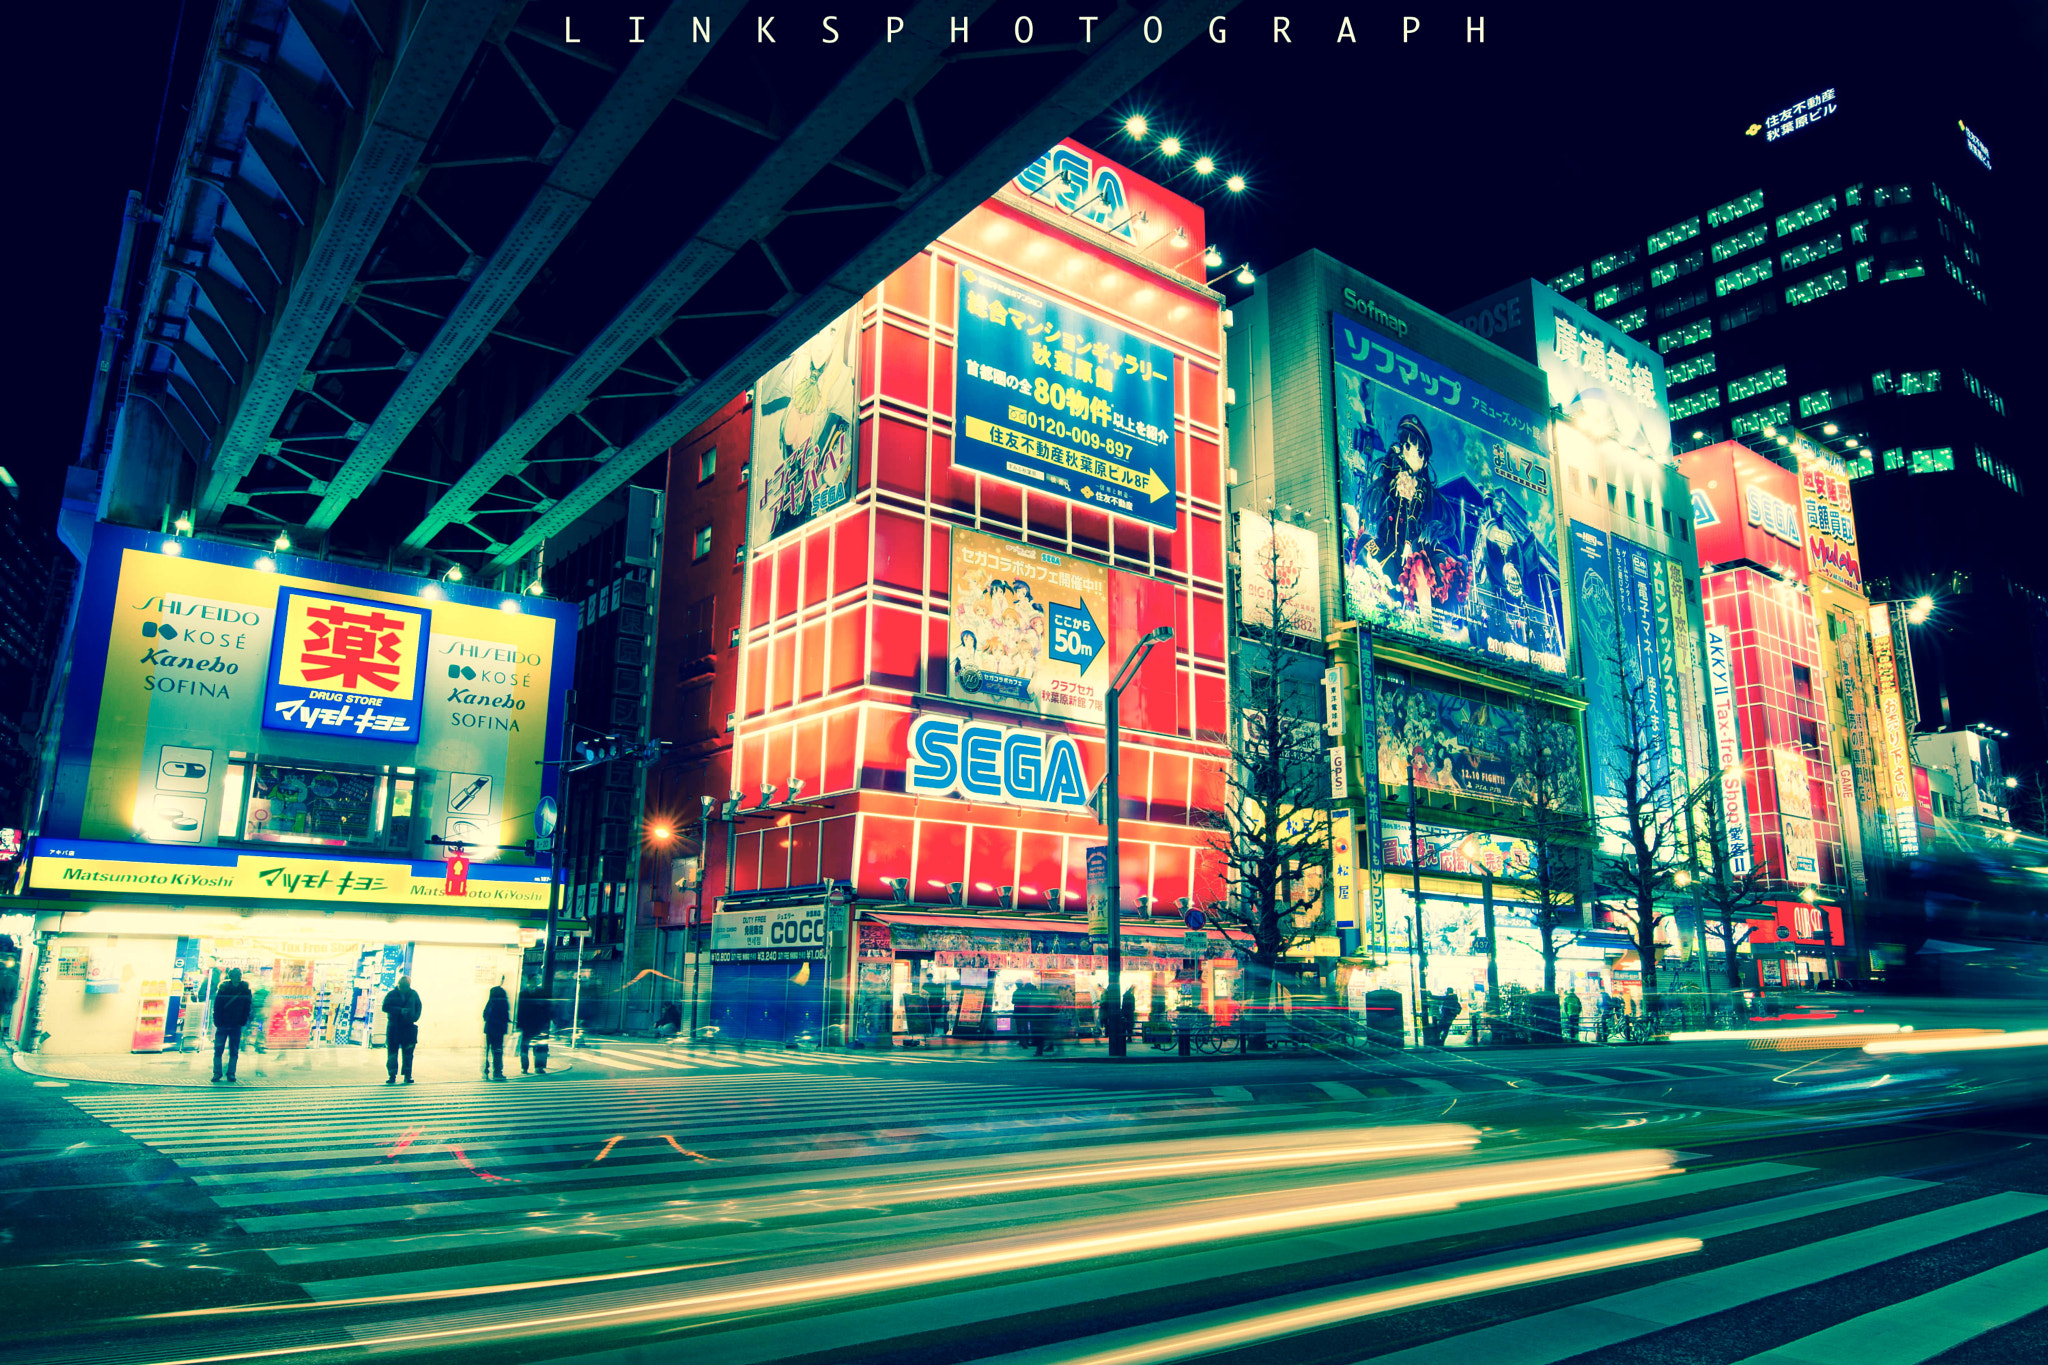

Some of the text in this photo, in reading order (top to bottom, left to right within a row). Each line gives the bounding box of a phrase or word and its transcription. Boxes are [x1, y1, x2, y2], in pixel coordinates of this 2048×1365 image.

[1764, 88, 1836, 129] 住友不動産
[1766, 102, 1837, 142] 秋葉原ビル
[1010, 145, 1137, 247] EGA
[1343, 287, 1408, 338] Sofmap
[966, 290, 1168, 381] 総合マンションギャラリー
[1344, 328, 1462, 406] ソフマップ
[1027, 411, 1133, 460] 0120-009-897
[990, 425, 1150, 489] 住友不動産秋葉原ビル8F
[811, 481, 846, 515] SEGA
[1095, 491, 1133, 511] 住友不動産
[1746, 486, 1801, 546] SEGA
[1805, 499, 1855, 545] 高額買取
[1041, 553, 1061, 566] SEGA
[132, 596, 259, 626] SHISEIDO
[1054, 613, 1091, 632] ここから
[184, 628, 246, 649] KOSÉ
[301, 605, 405, 692] 薬
[1055, 628, 1093, 657] 50m
[140, 648, 239, 675] Kanebo
[438, 641, 541, 666] SHISEIDO
[143, 675, 230, 699] SOFINA
[482, 669, 531, 688] KOSÉ
[984, 674, 1022, 687] セガコラボカフェ
[1051, 679, 1094, 697] クラブセガ
[309, 690, 383, 707] DRUG STORE
[447, 688, 525, 710] Kanebo
[1041, 689, 1086, 708] 秋葉原新館
[275, 699, 411, 734] マツモトキヨシ
[451, 712, 519, 732] SOFINA
[1709, 630, 1726, 681] AKKY
[1724, 776, 1741, 825] Shop
[908, 717, 1089, 809] SEGA
[1333, 756, 1343, 788] GPS
[1461, 768, 1480, 780] 12.10
[1841, 769, 1854, 799] GAME
[1367, 790, 1381, 866] サポートも
[62, 867, 234, 888] Matsumoto KiYoshi
[258, 866, 388, 895] マツモトキヨシ
[1337, 863, 1350, 901] 松屋
[410, 885, 542, 901] Matsoto KiYoshi
[1371, 872, 1384, 935] ソフマップ
[742, 915, 767, 925] DUTY FREE
[281, 941, 300, 952] Tax
[303, 942, 328, 953] Free
[1474, 941, 1489, 949] 437
